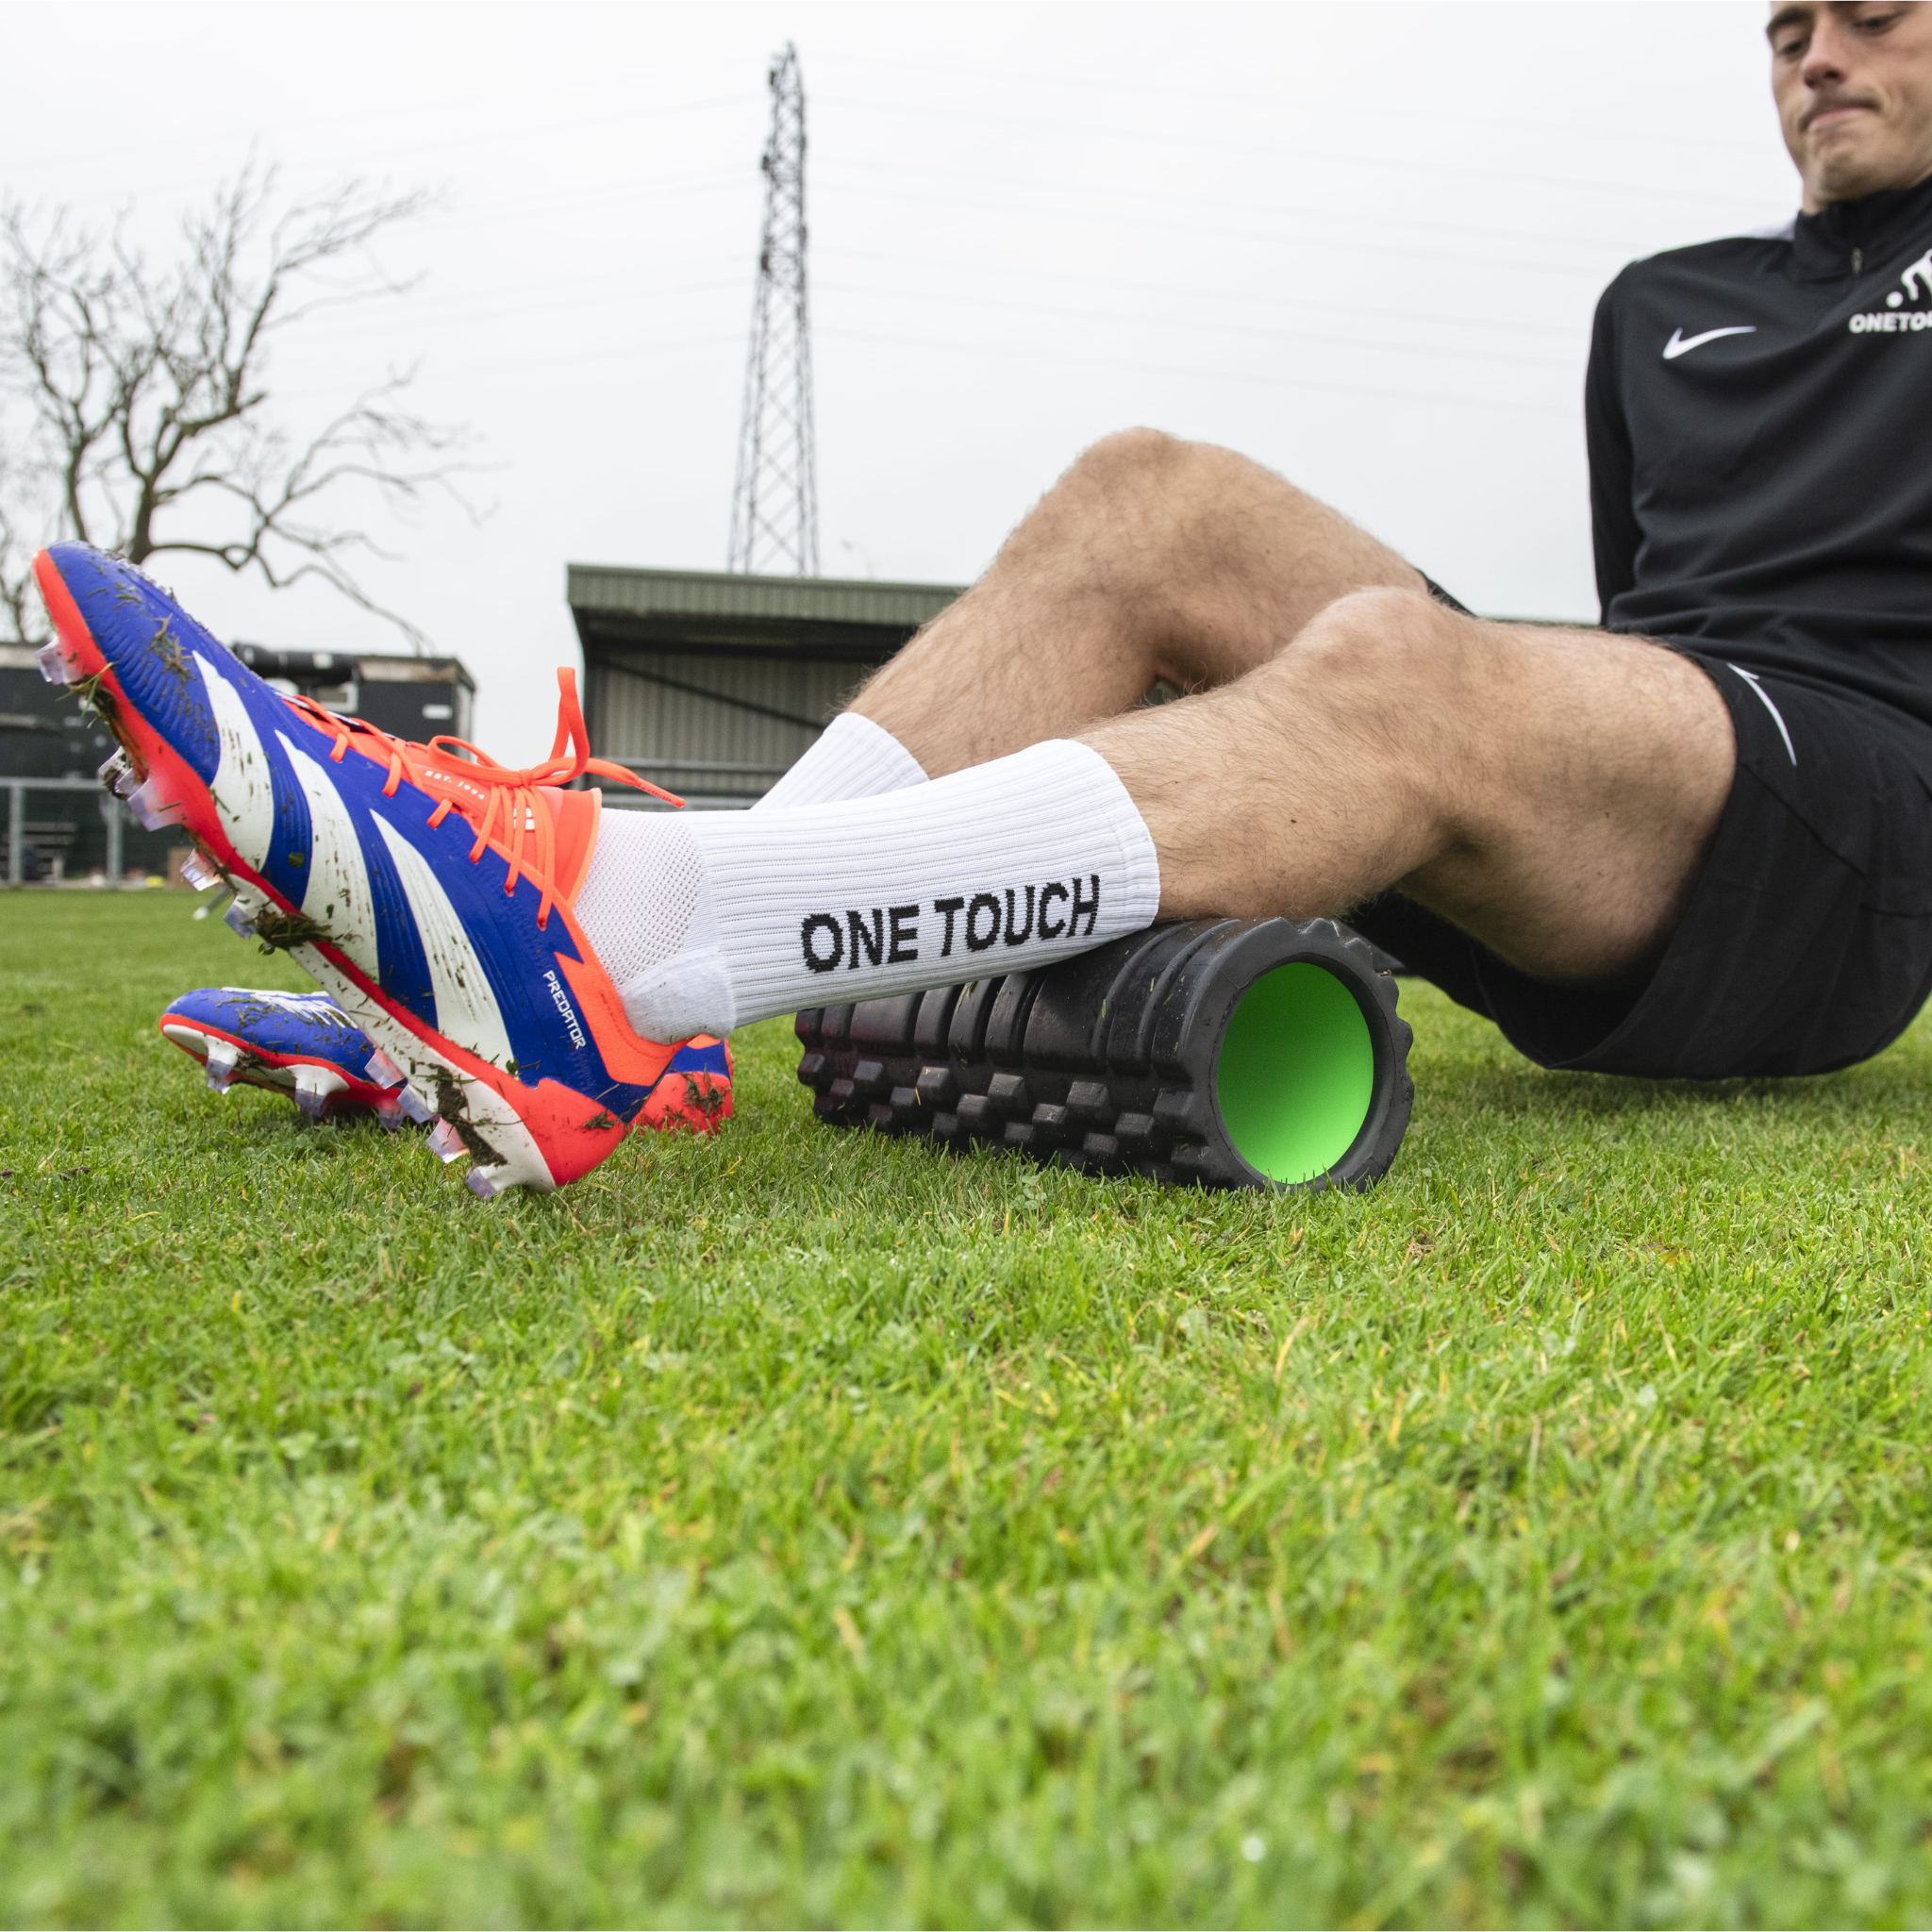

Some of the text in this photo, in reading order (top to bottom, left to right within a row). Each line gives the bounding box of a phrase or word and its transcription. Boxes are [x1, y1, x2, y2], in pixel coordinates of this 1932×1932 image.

[425, 770, 485, 800] EST. 1994
[801, 874, 1100, 974] ONE TOUCH
[542, 970, 587, 1050] PREDATOR
